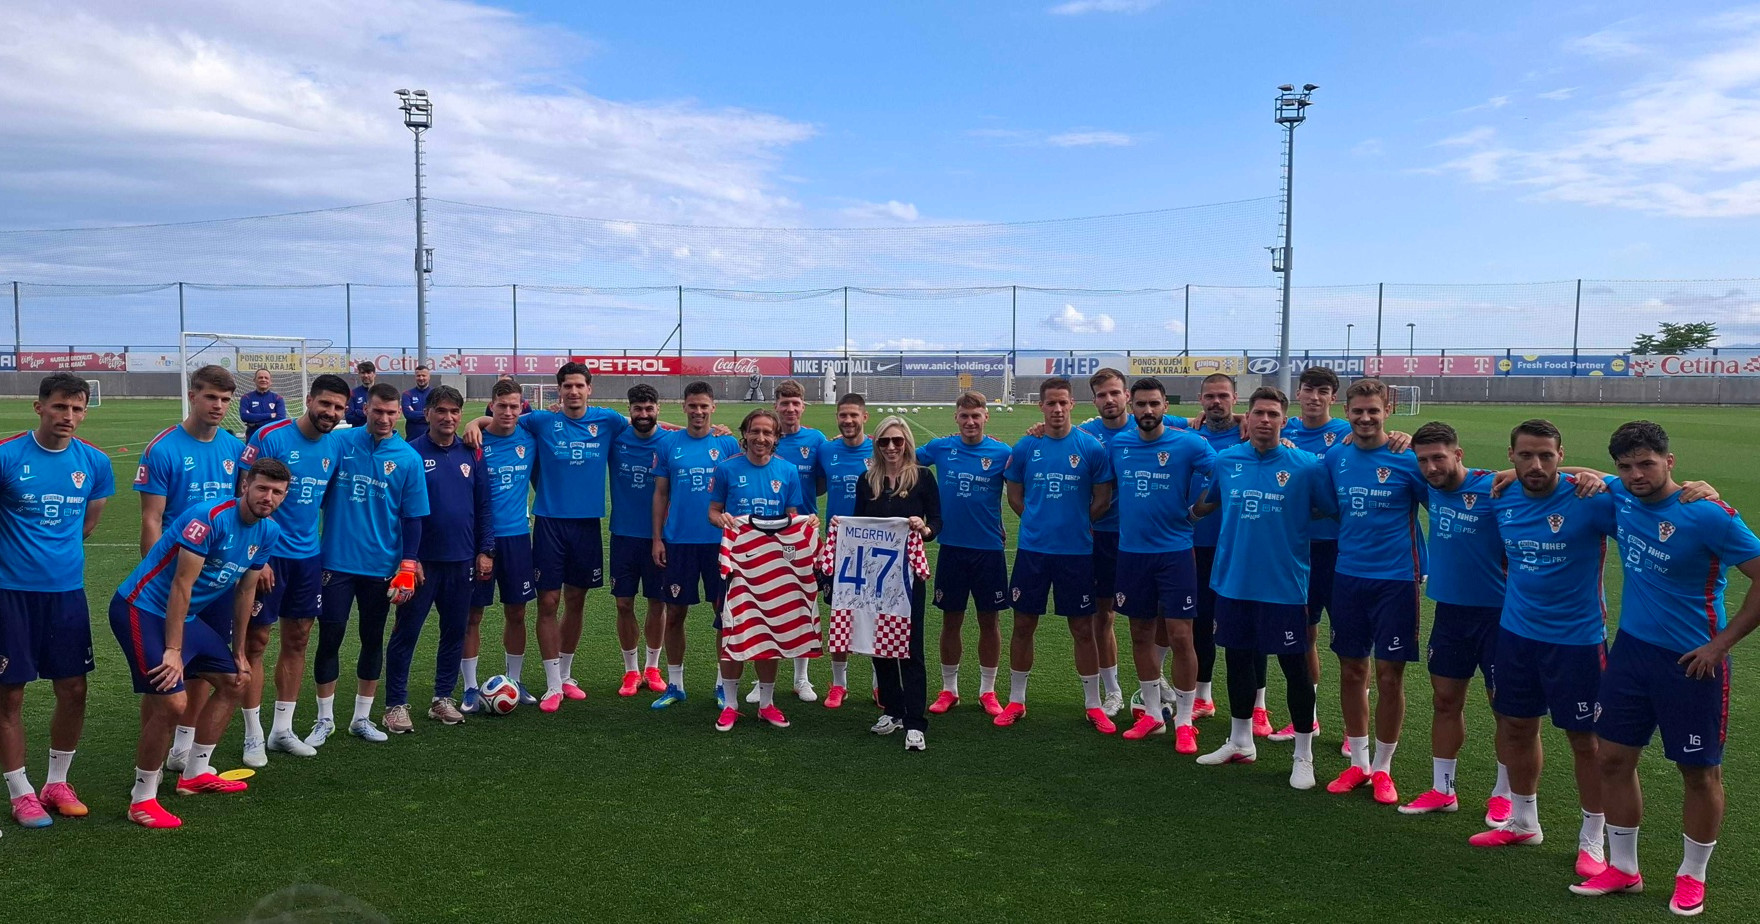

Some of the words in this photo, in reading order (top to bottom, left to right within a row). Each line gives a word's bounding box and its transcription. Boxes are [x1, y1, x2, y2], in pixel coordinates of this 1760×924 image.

[375, 354, 436, 371] Cetia
[584, 358, 670, 372] PETROL
[794, 360, 818, 373] NIKE
[822, 360, 874, 373] FOOTBALL
[1064, 358, 1100, 374] HEP
[1288, 360, 1364, 372] HYUNDAI
[1661, 356, 1739, 374] Cetina
[290, 450, 300, 459] 25
[184, 456, 194, 466] 22
[1340, 458, 1346, 466] 2
[24, 465, 30, 474] 11
[1236, 464, 1242, 472] 12
[1463, 513, 1478, 522] HEP
[188, 522, 206, 540] T
[845, 526, 896, 542] MCGRAW
[229, 534, 234, 543] 7
[1654, 550, 1671, 562] HEP
[838, 546, 898, 598] 47
[523, 581, 530, 589] 21
[995, 591, 1003, 599] 19
[1186, 596, 1192, 604] 6
[1284, 631, 1294, 640] 12
[1393, 636, 1400, 646] 2
[1577, 702, 1588, 712] 13
[1689, 734, 1701, 746] 16
